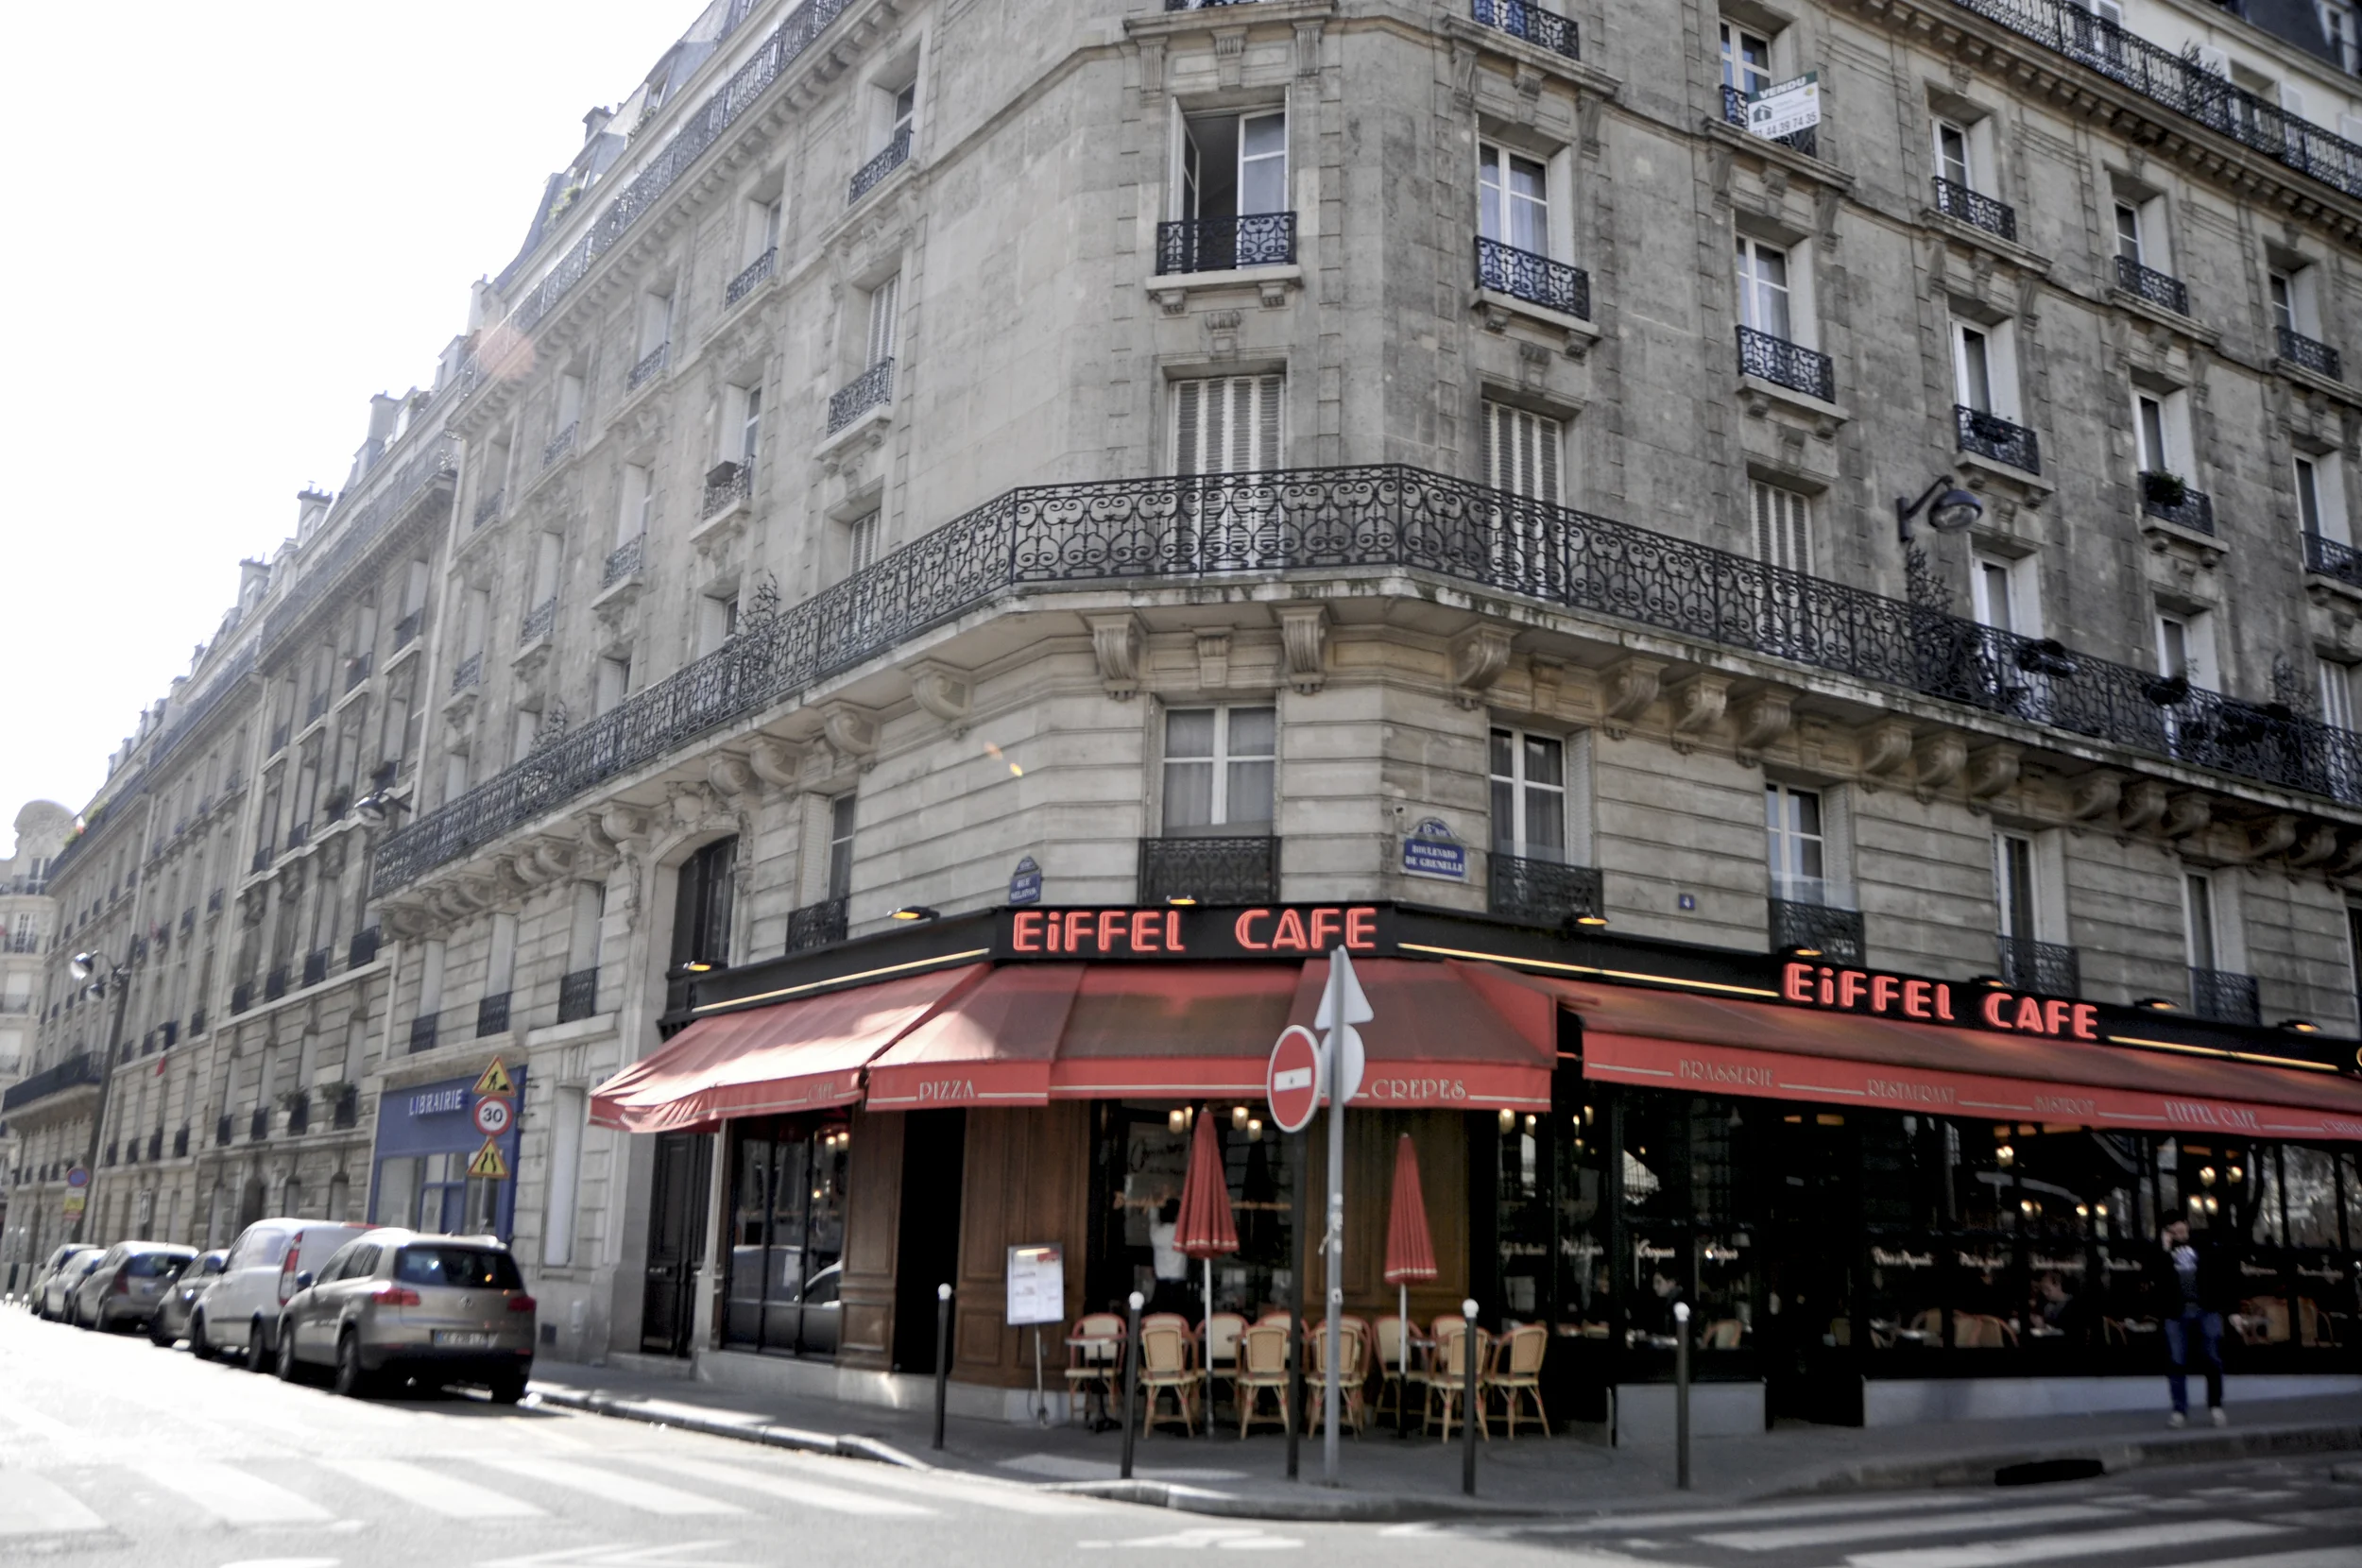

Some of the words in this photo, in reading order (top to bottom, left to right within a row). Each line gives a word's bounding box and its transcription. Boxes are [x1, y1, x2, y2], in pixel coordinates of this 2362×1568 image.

[1758, 76, 1807, 99] VENDU
[1766, 125, 1777, 136] 44
[1792, 116, 1804, 128] 74
[1806, 111, 1817, 125] 35
[1405, 855, 1417, 865] DE
[1419, 857, 1464, 873] GRENELLE
[1412, 844, 1458, 860] BOULEVARD
[1235, 907, 1377, 950] CAFE
[1984, 992, 2097, 1040] CAFE
[1678, 1058, 1774, 1088] BRASSERIE
[918, 1079, 976, 1101] PIZZA
[1371, 1078, 1467, 1100] CREPES
[1867, 1078, 1958, 1104] RESTAURANT
[408, 1088, 464, 1116] LIBRAIRIE
[2032, 1094, 2097, 1116] BISTROT
[483, 1107, 504, 1123] 30
[2164, 1100, 2217, 1125] EIFFEL
[2218, 1106, 2262, 1131] CAFE
